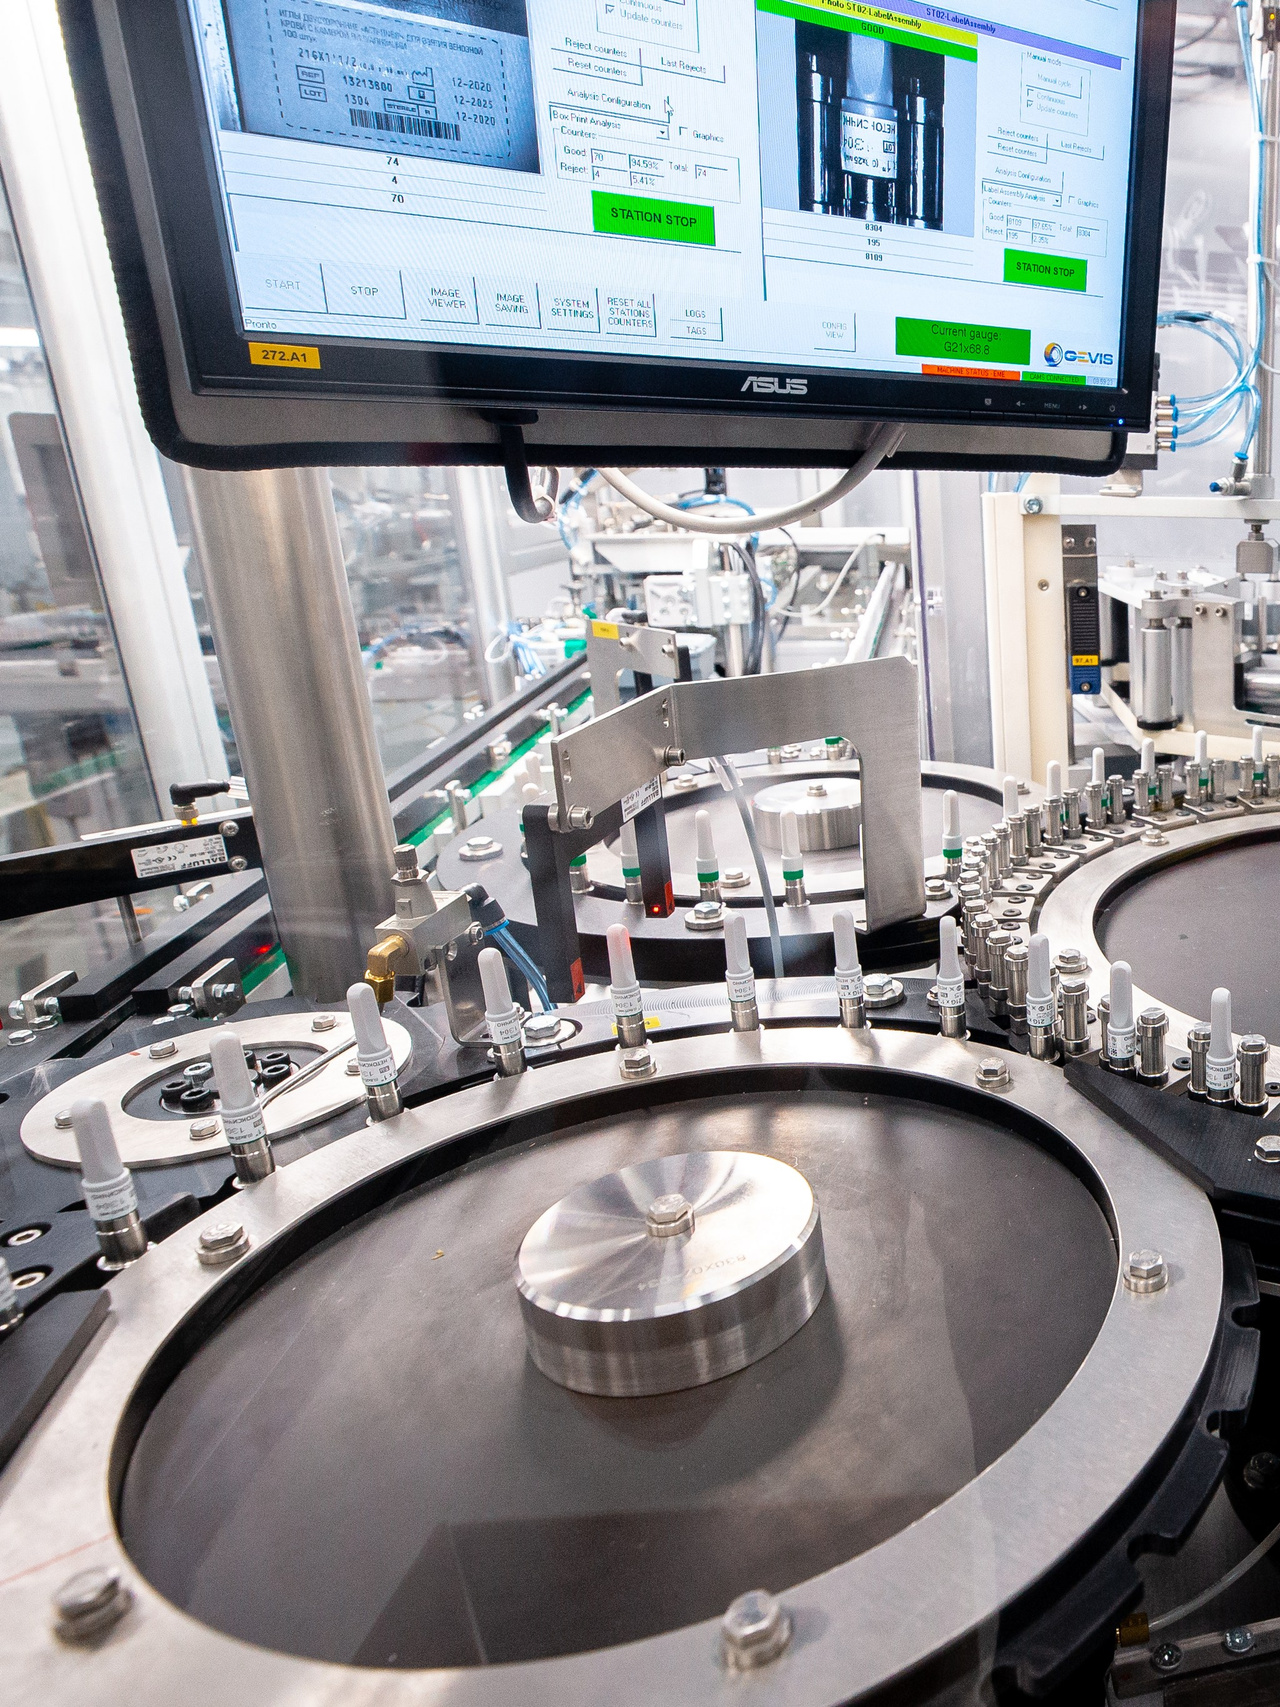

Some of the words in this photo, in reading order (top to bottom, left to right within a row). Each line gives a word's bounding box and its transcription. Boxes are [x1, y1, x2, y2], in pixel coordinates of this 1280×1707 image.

[620, 8, 649, 23] Update
[651, 17, 683, 30] counters
[283, 29, 297, 39] 100
[861, 22, 884, 35] GOOD
[565, 37, 592, 51] Reject
[593, 44, 628, 58] counters
[568, 57, 591, 70] Reset
[593, 63, 628, 77] counters
[660, 56, 678, 67] Last
[679, 60, 706, 75] Rejects
[452, 77, 492, 93] 12-2020
[303, 88, 322, 98] LOT
[344, 93, 370, 107] 1304
[454, 95, 493, 109] 12-2025
[567, 88, 599, 102] Analysis
[600, 94, 651, 111] Configuration
[456, 111, 496, 127] 12-2020
[552, 110, 570, 121] Box
[571, 112, 588, 124] Print
[589, 116, 621, 130] Analysis
[692, 130, 724, 143] Graphics
[386, 156, 399, 166] 74
[594, 152, 604, 162] 70
[631, 158, 659, 170] 94.59%
[697, 168, 707, 178] 74
[391, 176, 398, 185] 4
[594, 170, 600, 178] 4
[632, 175, 655, 186] 5.41%
[391, 193, 404, 204] 70
[610, 207, 662, 223] STATION
[665, 214, 697, 228] STOP
[865, 223, 882, 232] 8304
[867, 238, 881, 247] 195
[865, 252, 883, 261] 8109
[1016, 261, 1051, 275] STATION
[1053, 266, 1075, 278] STOP
[265, 278, 300, 290] START
[350, 285, 379, 296] STOP
[430, 287, 461, 298] IMAGE
[428, 298, 466, 309] VIEWER
[496, 292, 525, 304] IMAGE
[553, 297, 590, 309] SYSTEM
[607, 296, 634, 307] RESET
[636, 298, 651, 309] ALL
[494, 303, 529, 314] SAVING
[551, 308, 595, 319] SETTINGS
[609, 307, 651, 319] STATIONS
[685, 309, 706, 319] LOGS
[245, 318, 277, 330] Pronto
[608, 317, 653, 329] COUNTERS
[686, 326, 707, 336] TAGS
[825, 330, 844, 339] VIEW
[931, 324, 967, 337] Current
[969, 327, 1002, 341] gauge:
[943, 341, 990, 356] G21x68.8
[261, 350, 308, 363] 272.A1
[1064, 350, 1114, 366] GEVIS
[937, 366, 965, 376] MACHINE
[966, 367, 989, 378] STATUS
[740, 376, 808, 395] ASUS
[181, 856, 225, 870] BALLUFF
